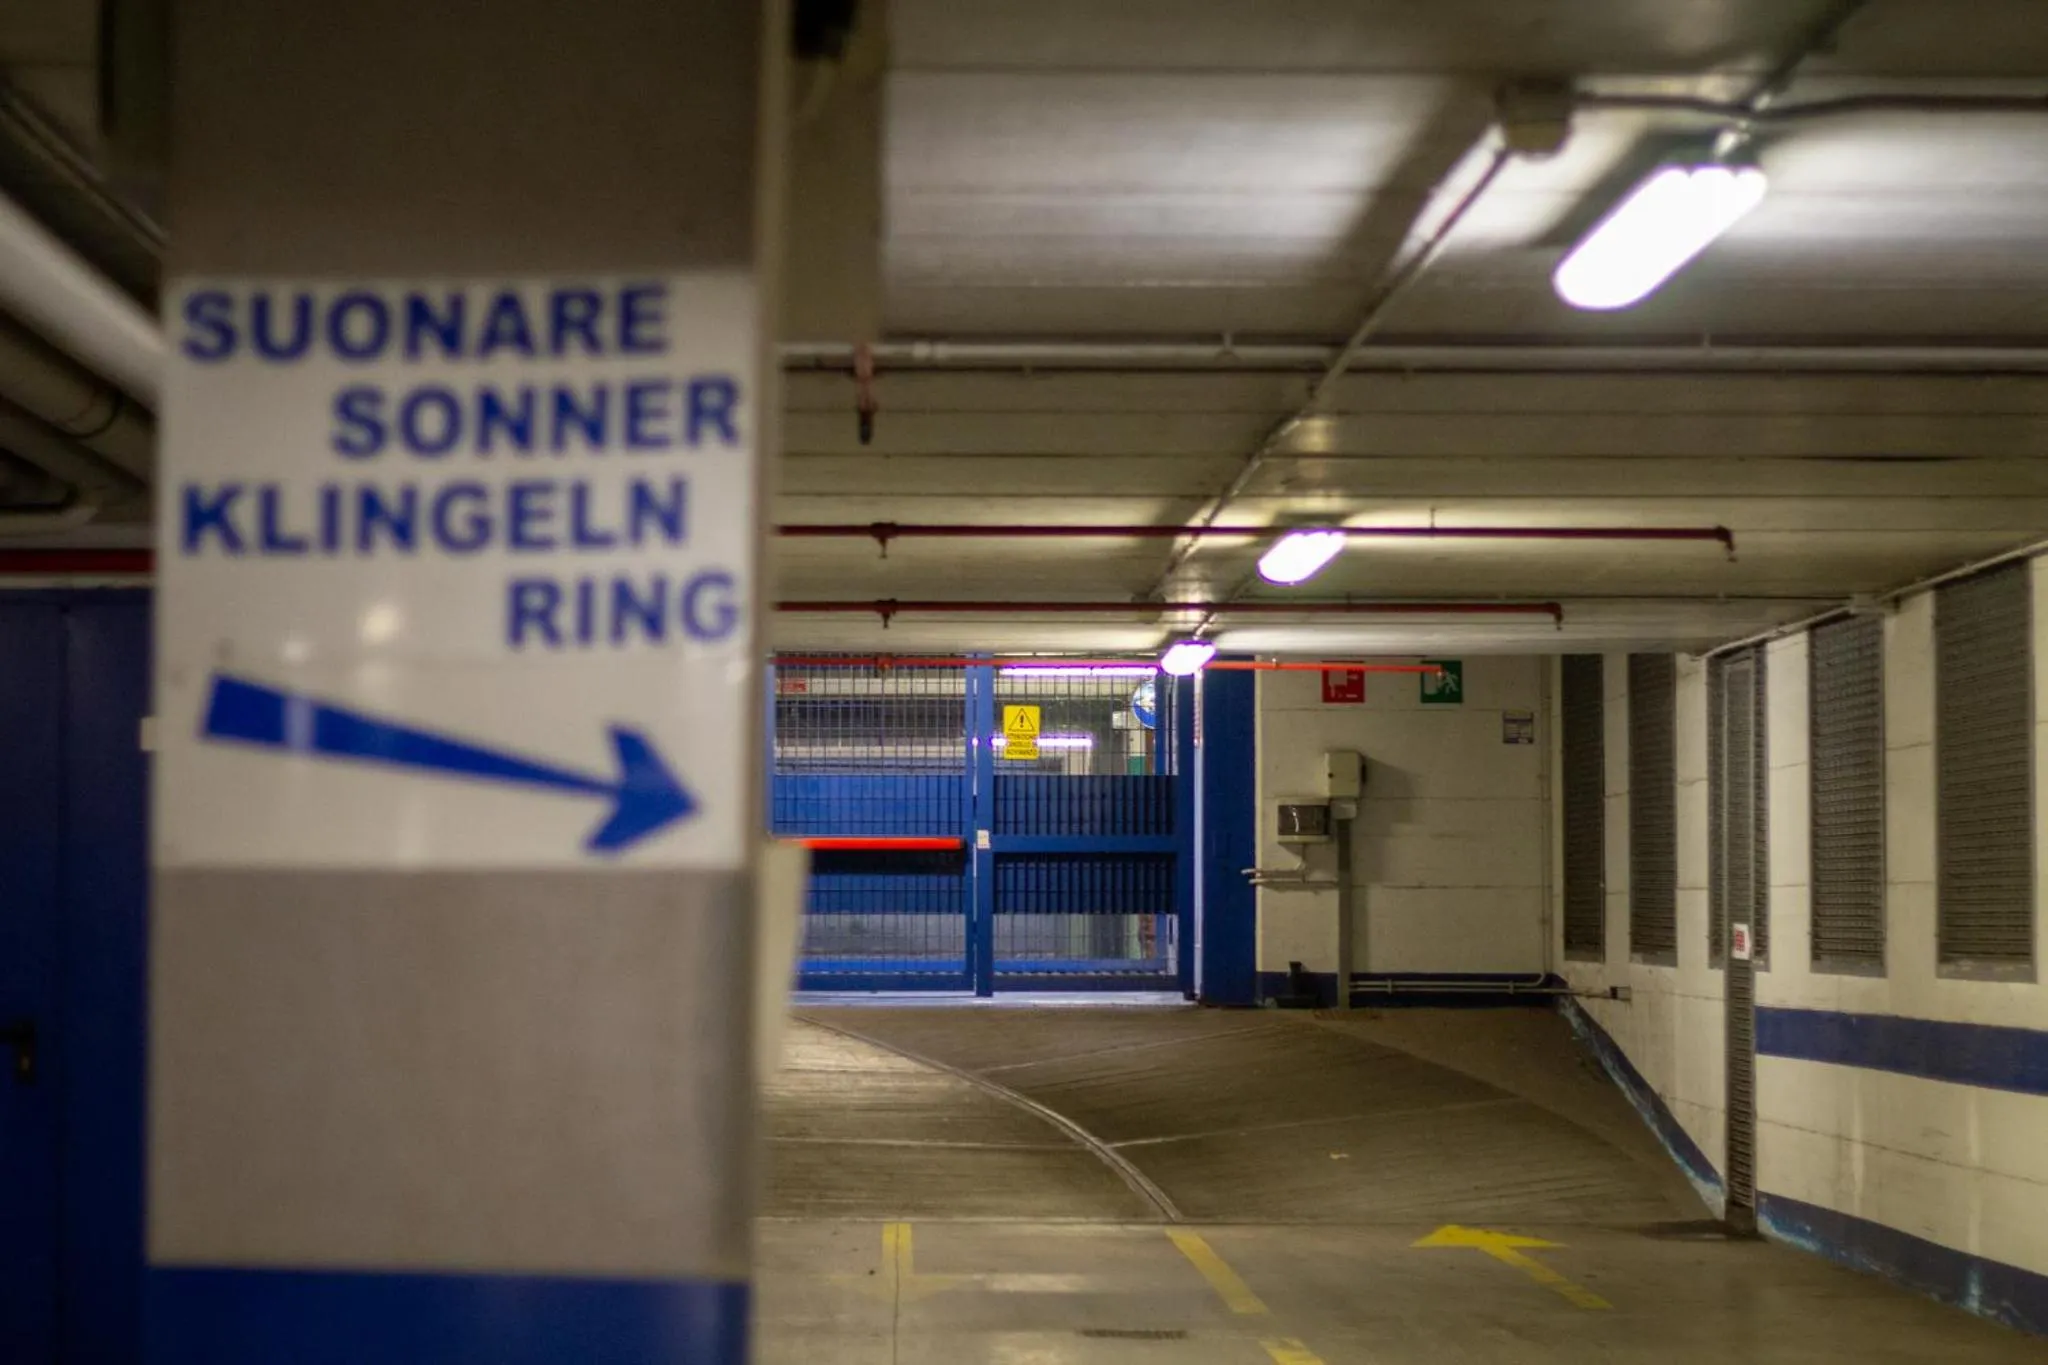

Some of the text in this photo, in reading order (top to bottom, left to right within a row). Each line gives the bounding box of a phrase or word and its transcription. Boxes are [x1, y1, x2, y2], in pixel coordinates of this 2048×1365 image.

[182, 283, 670, 363] SUONARE
[332, 375, 740, 459] SONNER
[180, 477, 688, 555] KLINGELN
[506, 571, 740, 648] RING
